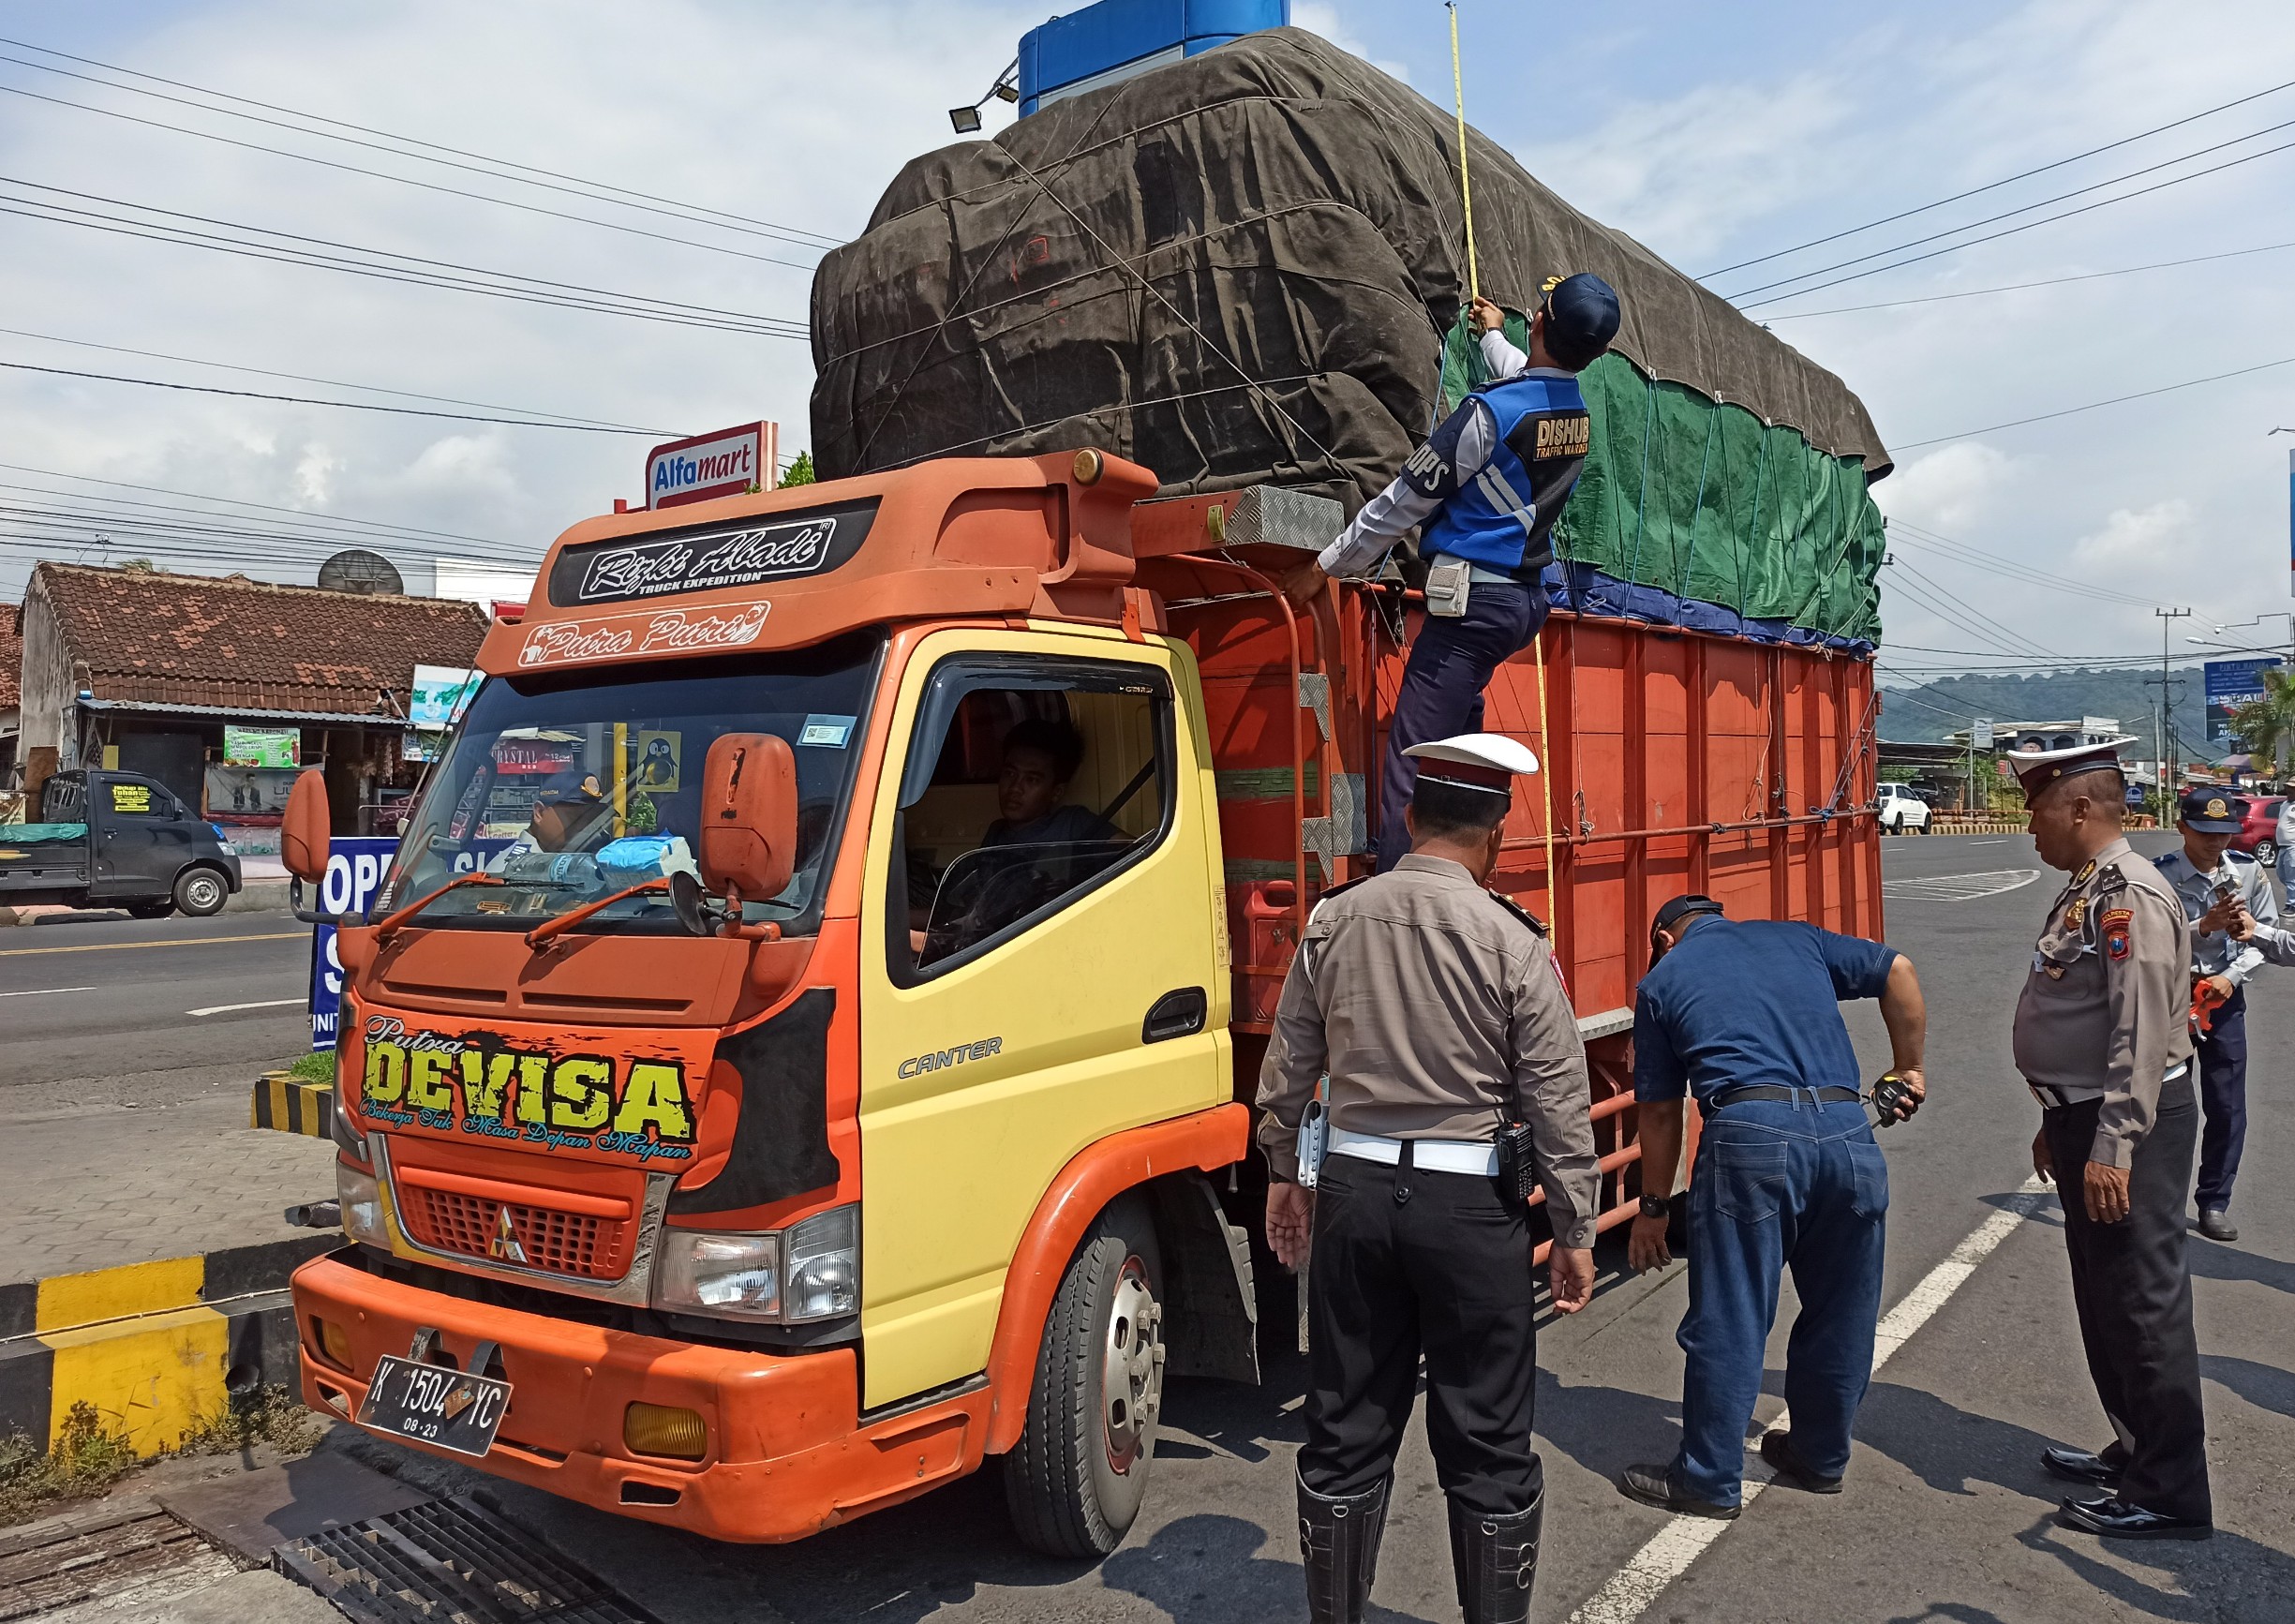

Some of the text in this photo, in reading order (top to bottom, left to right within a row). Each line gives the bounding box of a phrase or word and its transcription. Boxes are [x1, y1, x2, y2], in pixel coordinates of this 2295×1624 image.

[1537, 417, 1589, 447] DISHUB
[1537, 446, 1563, 459] TRAFFIC
[654, 443, 752, 491] Alfamart
[589, 528, 824, 595] Rizki Abadi
[639, 571, 763, 595] TRUCK EXPEDITION
[540, 612, 745, 662] Putra Putri
[365, 1015, 466, 1055] Putra
[898, 1035, 1003, 1080] CANTER
[365, 1040, 691, 1139] DEVISA
[359, 1098, 692, 1162] Bekerja Tuk Masa Depan Mapan
[371, 1361, 501, 1429] K 1504 YC
